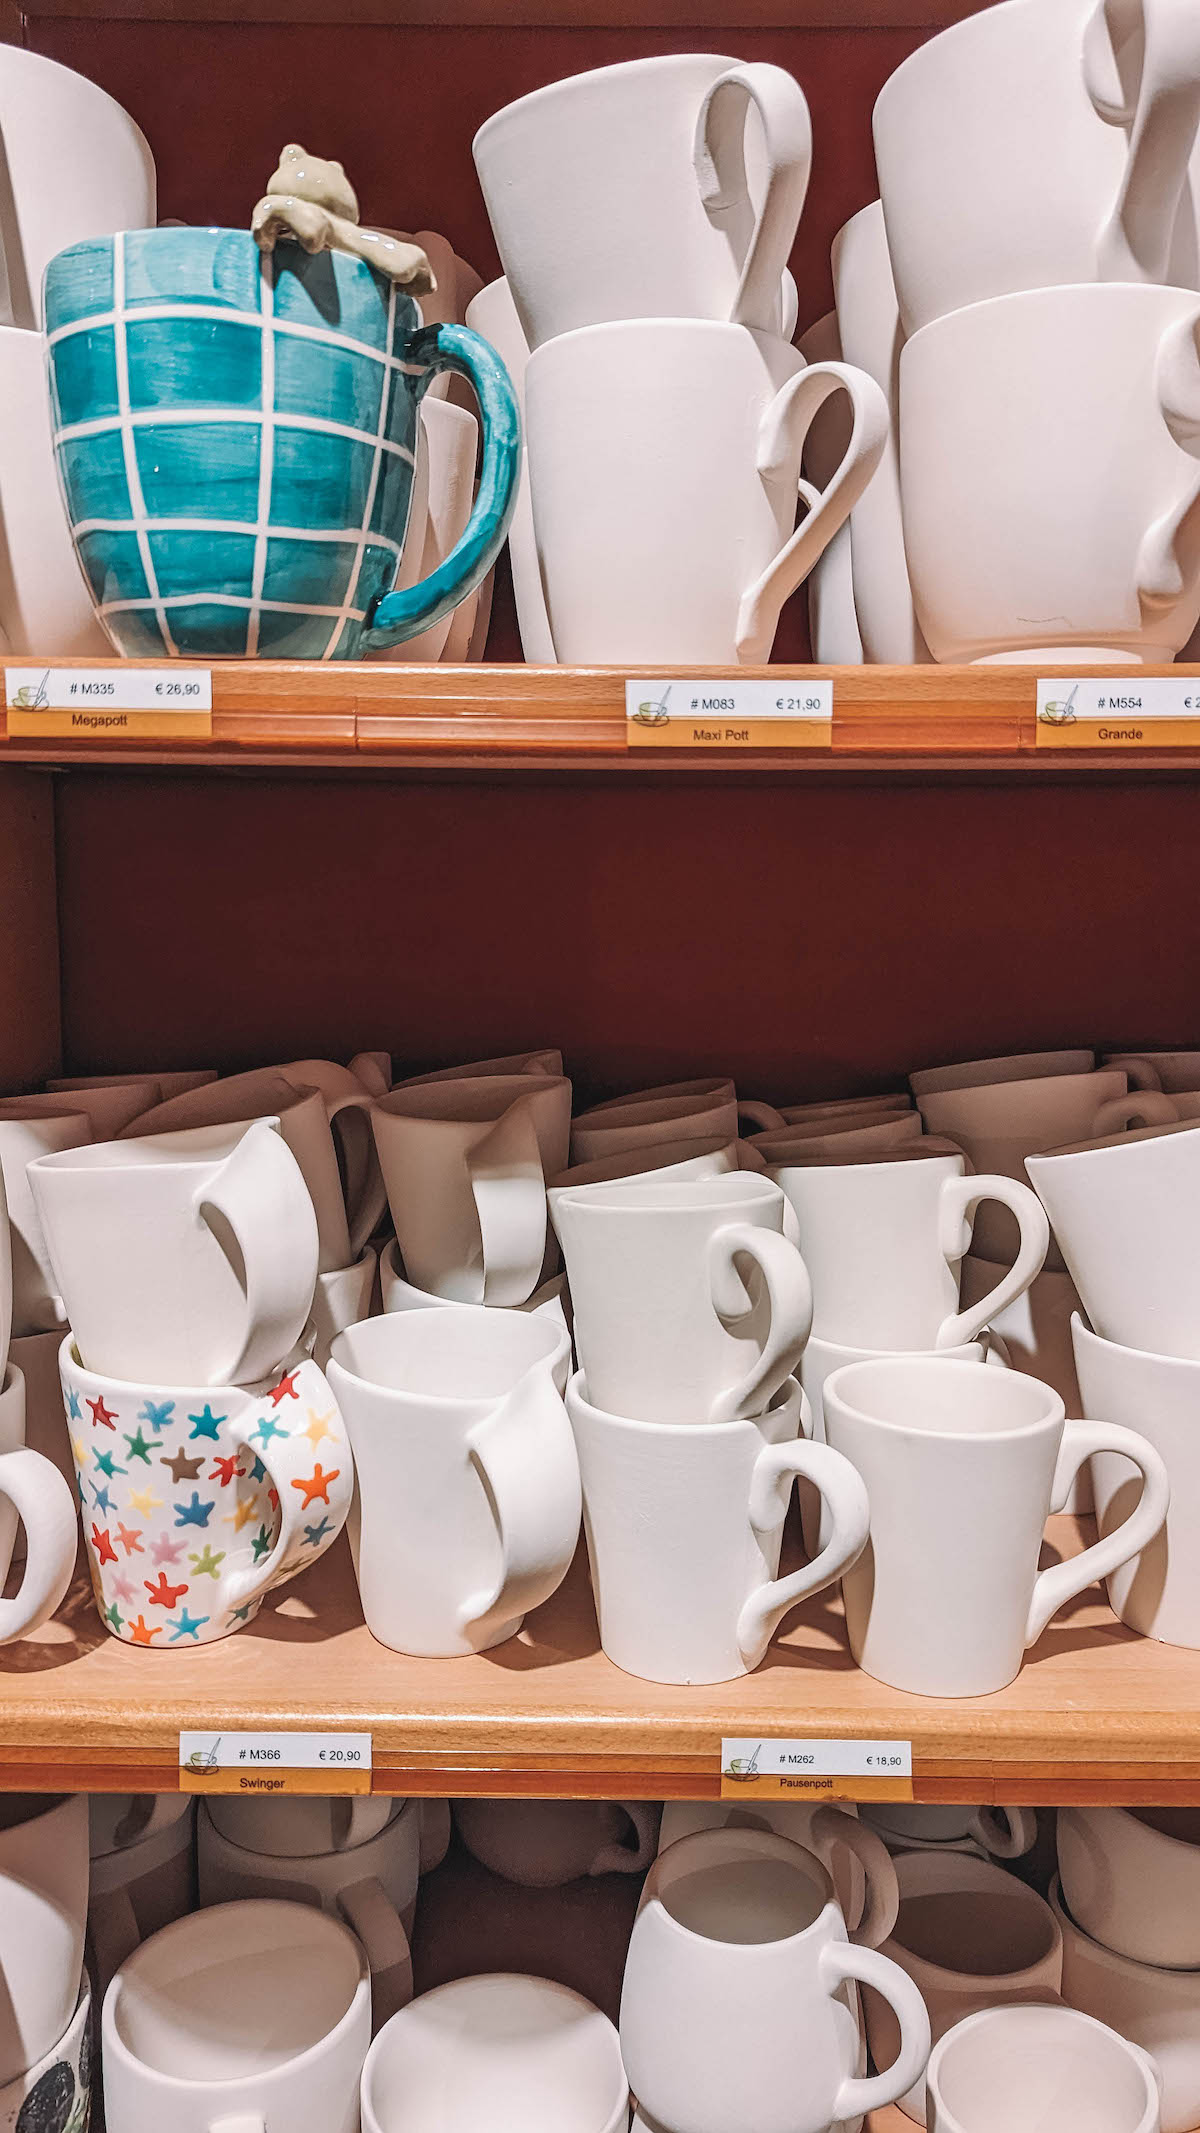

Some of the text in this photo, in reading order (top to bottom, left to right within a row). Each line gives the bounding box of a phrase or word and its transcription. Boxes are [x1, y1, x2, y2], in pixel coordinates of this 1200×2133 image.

[70, 683, 200, 697] # M335 € 26,90
[690, 698, 821, 711] # M083 € 21,90
[1097, 697, 1106, 709] #
[1109, 697, 1142, 709] M554
[1183, 696, 1192, 709] €
[71, 714, 128, 729] Megapott
[693, 729, 749, 741] Maxi Pott
[1098, 728, 1143, 740] Grande
[239, 1749, 361, 1762] # M366 € 20,90
[779, 1754, 902, 1767] # M262 € 18,90
[239, 1778, 285, 1790] Swinger
[780, 1778, 833, 1790] Pausenpott
